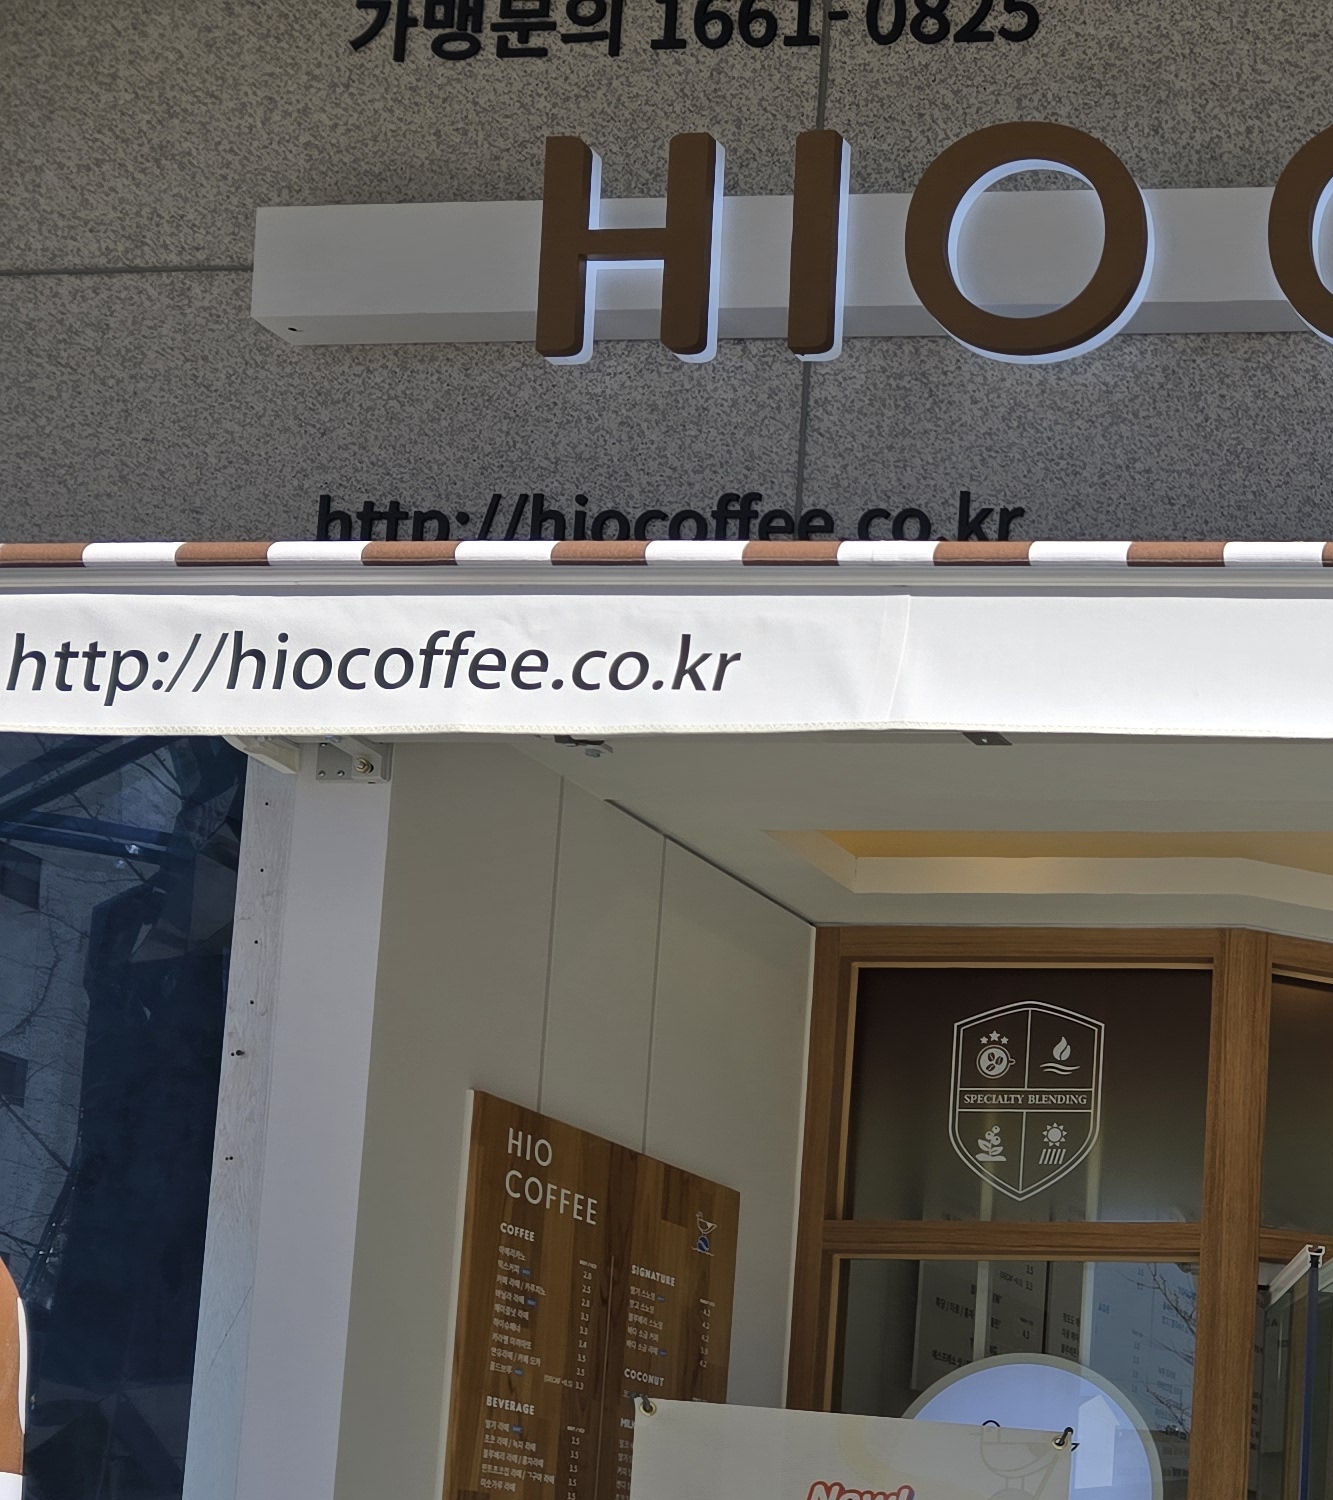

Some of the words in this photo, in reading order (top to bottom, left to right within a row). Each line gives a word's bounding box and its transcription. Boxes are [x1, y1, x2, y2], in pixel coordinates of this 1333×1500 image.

[536, 120, 1155, 364] HIO
[316, 491, 1025, 541] http://hiocoffeeco.kr
[6, 630, 742, 706] http://hiocoffee.co.kr
[963, 1094, 1024, 1105] SPECIALTY
[1027, 1095, 1087, 1106] BLENDING
[507, 1128, 552, 1166] HIO
[505, 1170, 598, 1226] COFFEE
[500, 1222, 535, 1242] COFFEE
[631, 1264, 675, 1286] SIGNATURE
[624, 1368, 664, 1387] COCONUT
[486, 1396, 535, 1415] BEVERAGE
